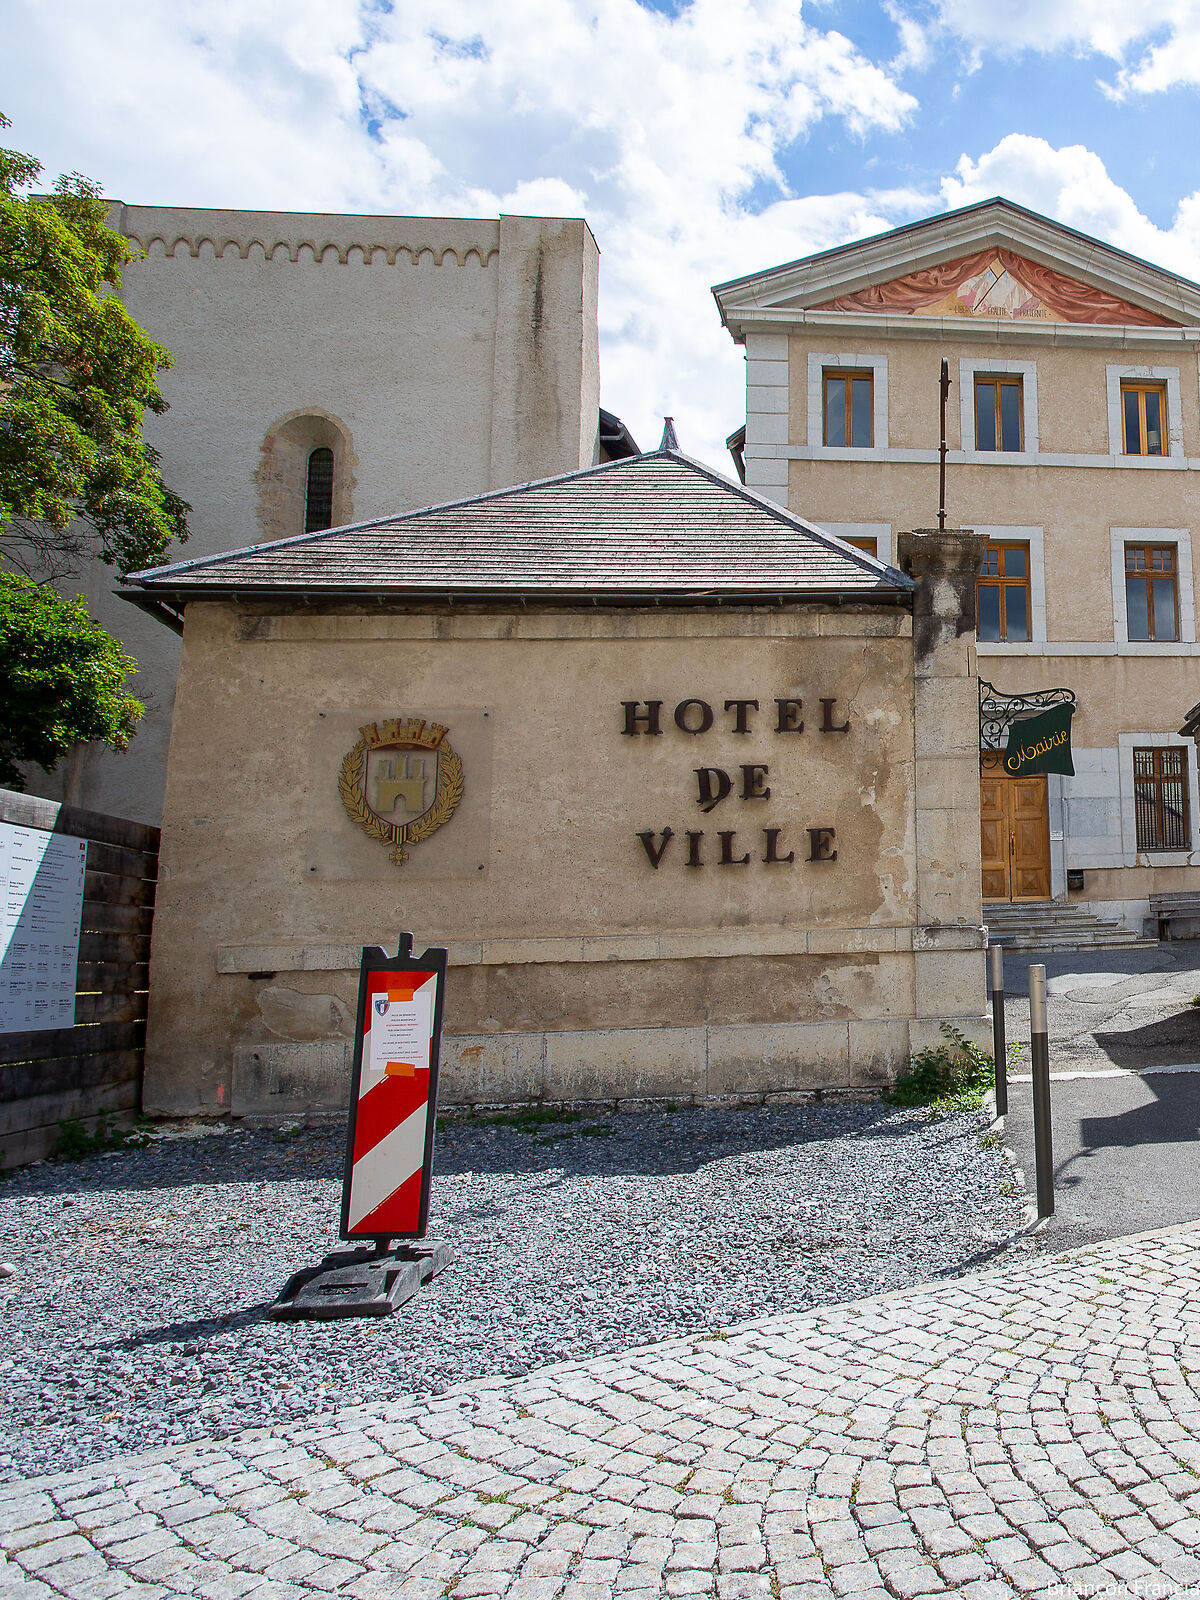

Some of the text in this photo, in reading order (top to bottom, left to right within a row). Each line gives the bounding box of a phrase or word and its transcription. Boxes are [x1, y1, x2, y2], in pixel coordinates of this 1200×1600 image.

[620, 698, 851, 737] HOTEL
[1007, 730, 1069, 770] Mairie
[693, 764, 771, 814] DE
[635, 827, 838, 869] VILLE
